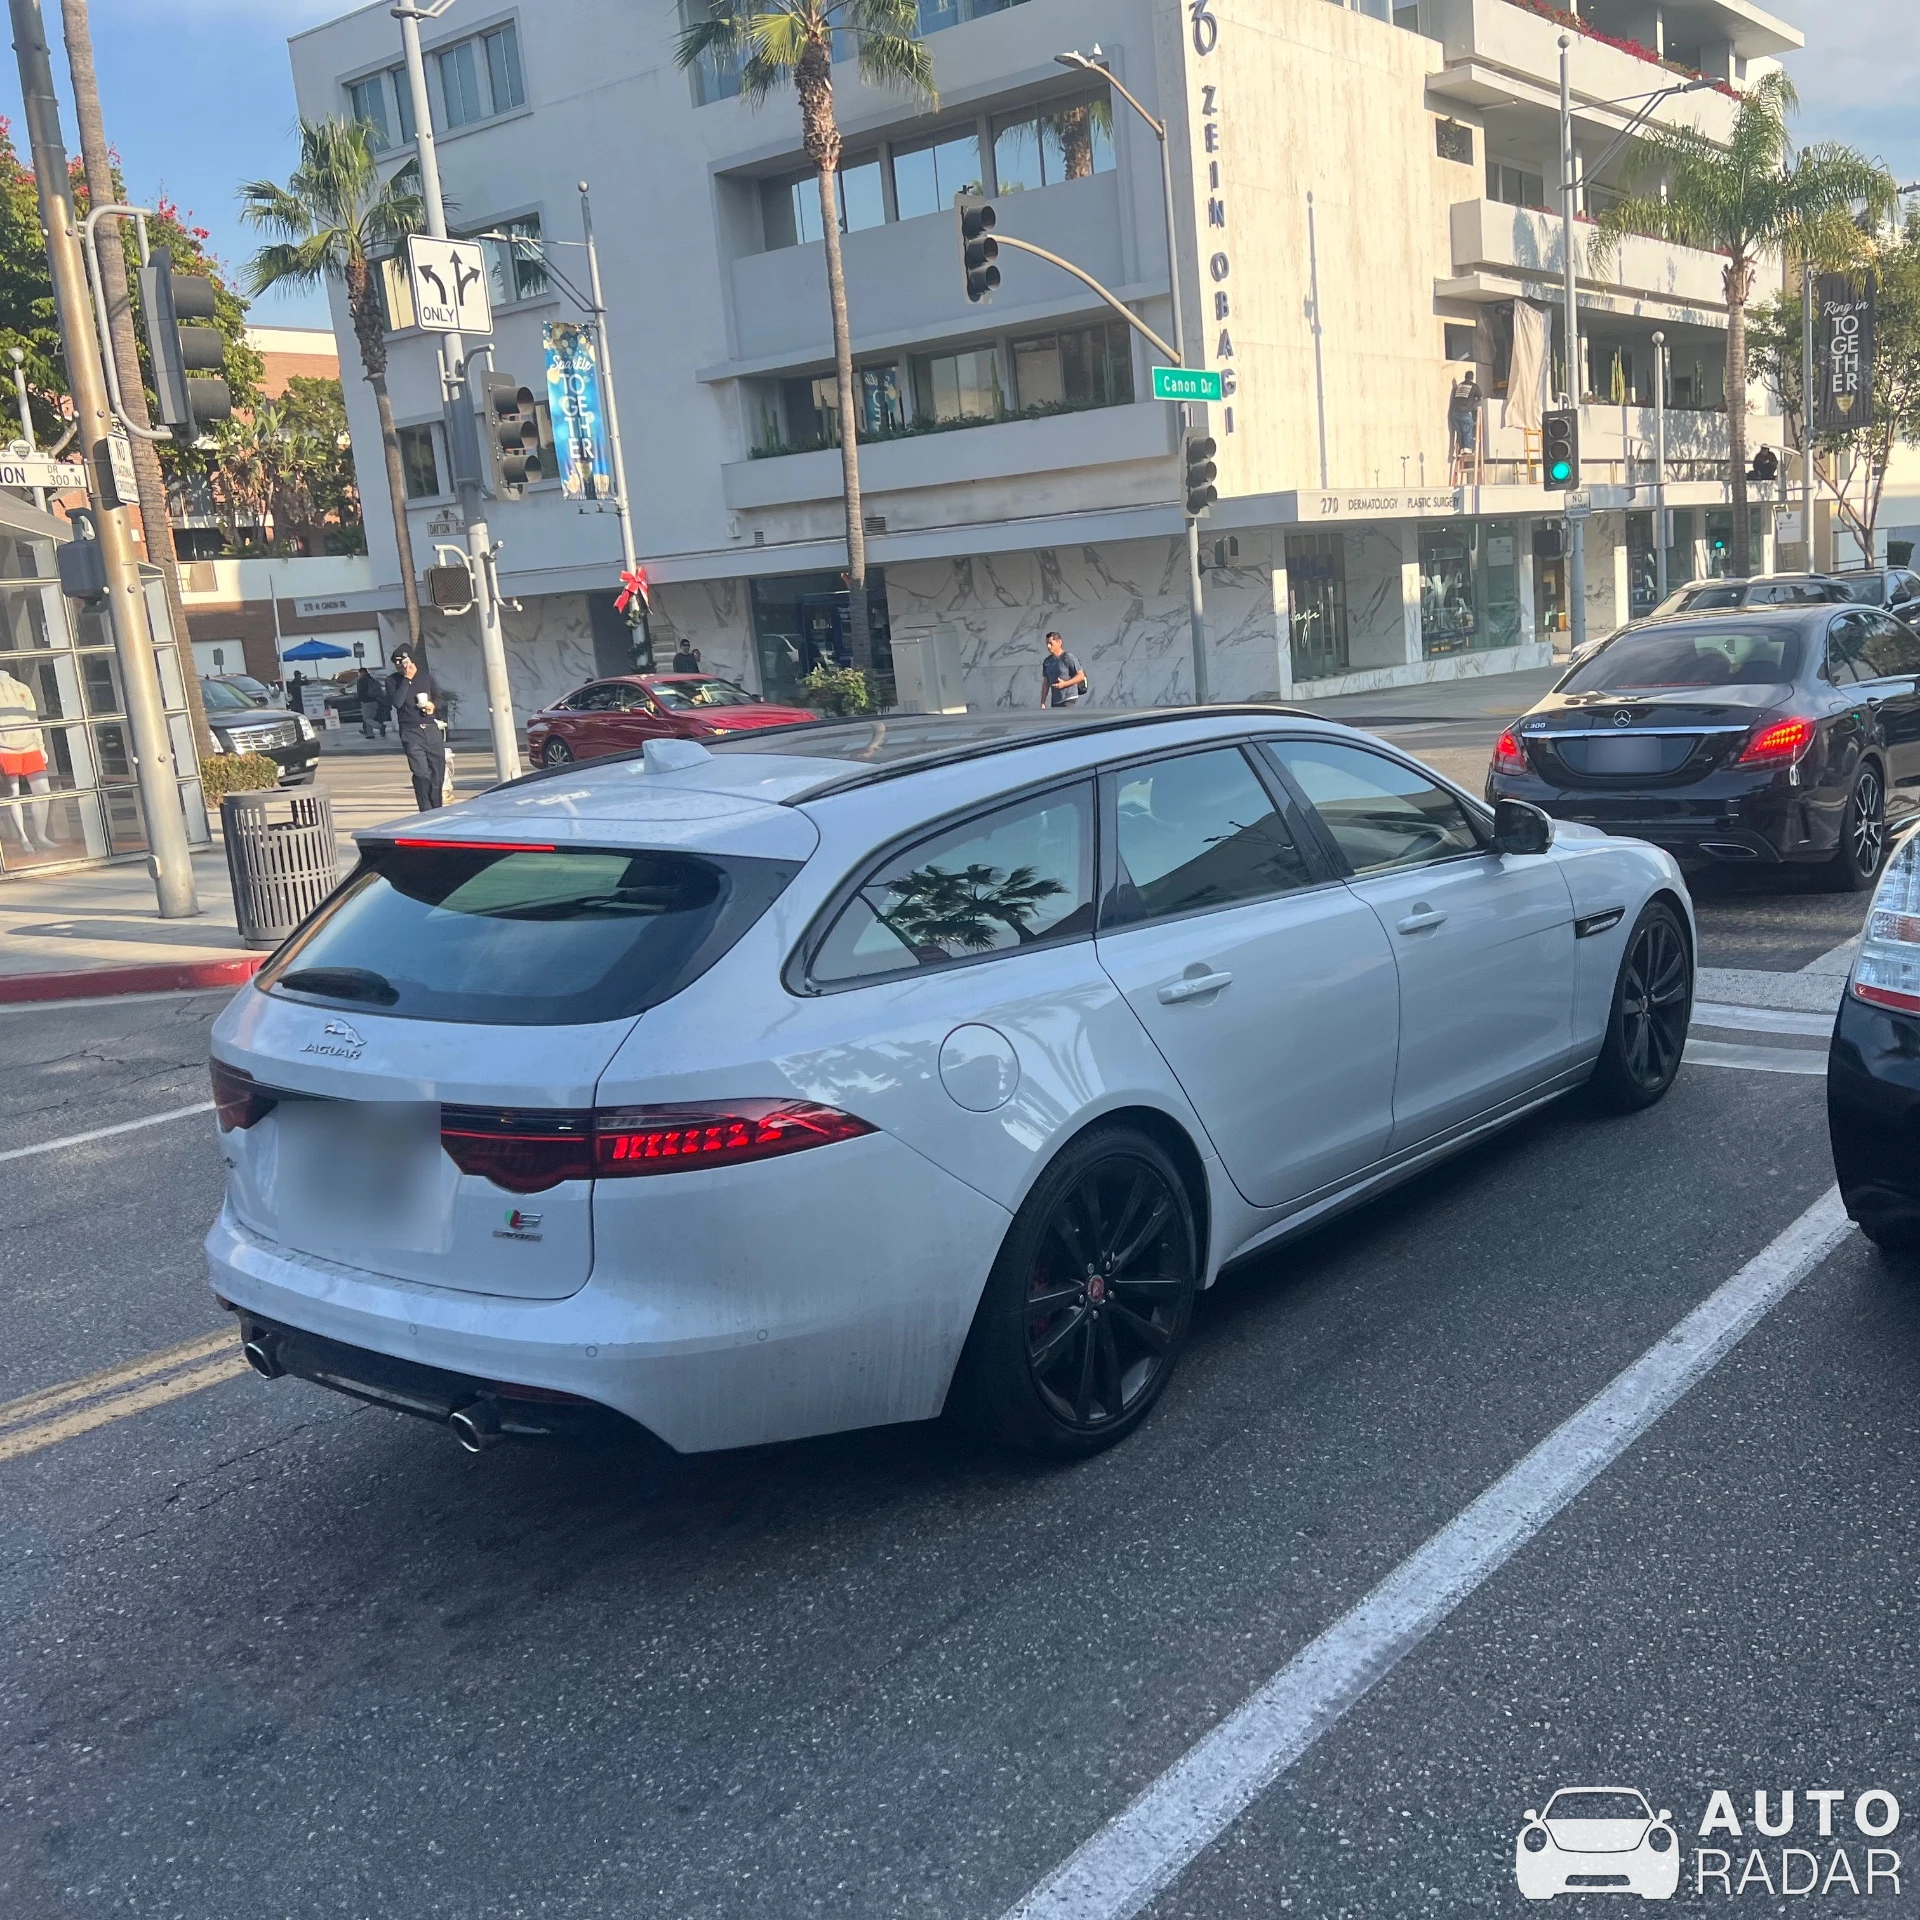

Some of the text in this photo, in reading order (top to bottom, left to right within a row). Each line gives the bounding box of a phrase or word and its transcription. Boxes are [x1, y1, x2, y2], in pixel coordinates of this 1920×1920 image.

[1202, 85, 1237, 436] ZEIN OBAGI
[423, 306, 454, 322] ONLY
[1823, 300, 1869, 316] Ring in
[1832, 315, 1859, 335] TO
[1830, 334, 1859, 355] GE
[550, 354, 594, 371] Sparkle
[1831, 353, 1859, 374] TH
[559, 373, 585, 395] TO
[1163, 375, 1213, 394] Canon Dr
[1832, 373, 1858, 393] ER
[561, 395, 589, 417] GE
[564, 416, 595, 438] TH
[115, 440, 126, 461] NO
[568, 438, 595, 459] ER
[0, 467, 26, 484] ON
[47, 465, 59, 474] DR
[50, 475, 82, 486] 300 N
[1320, 496, 1460, 514] 270 DERMATOLOGY PLASTIC SURGERY
[1572, 494, 1582, 503] NO
[430, 523, 450, 535] DAYTON
[299, 1043, 362, 1060] JAGUAR
